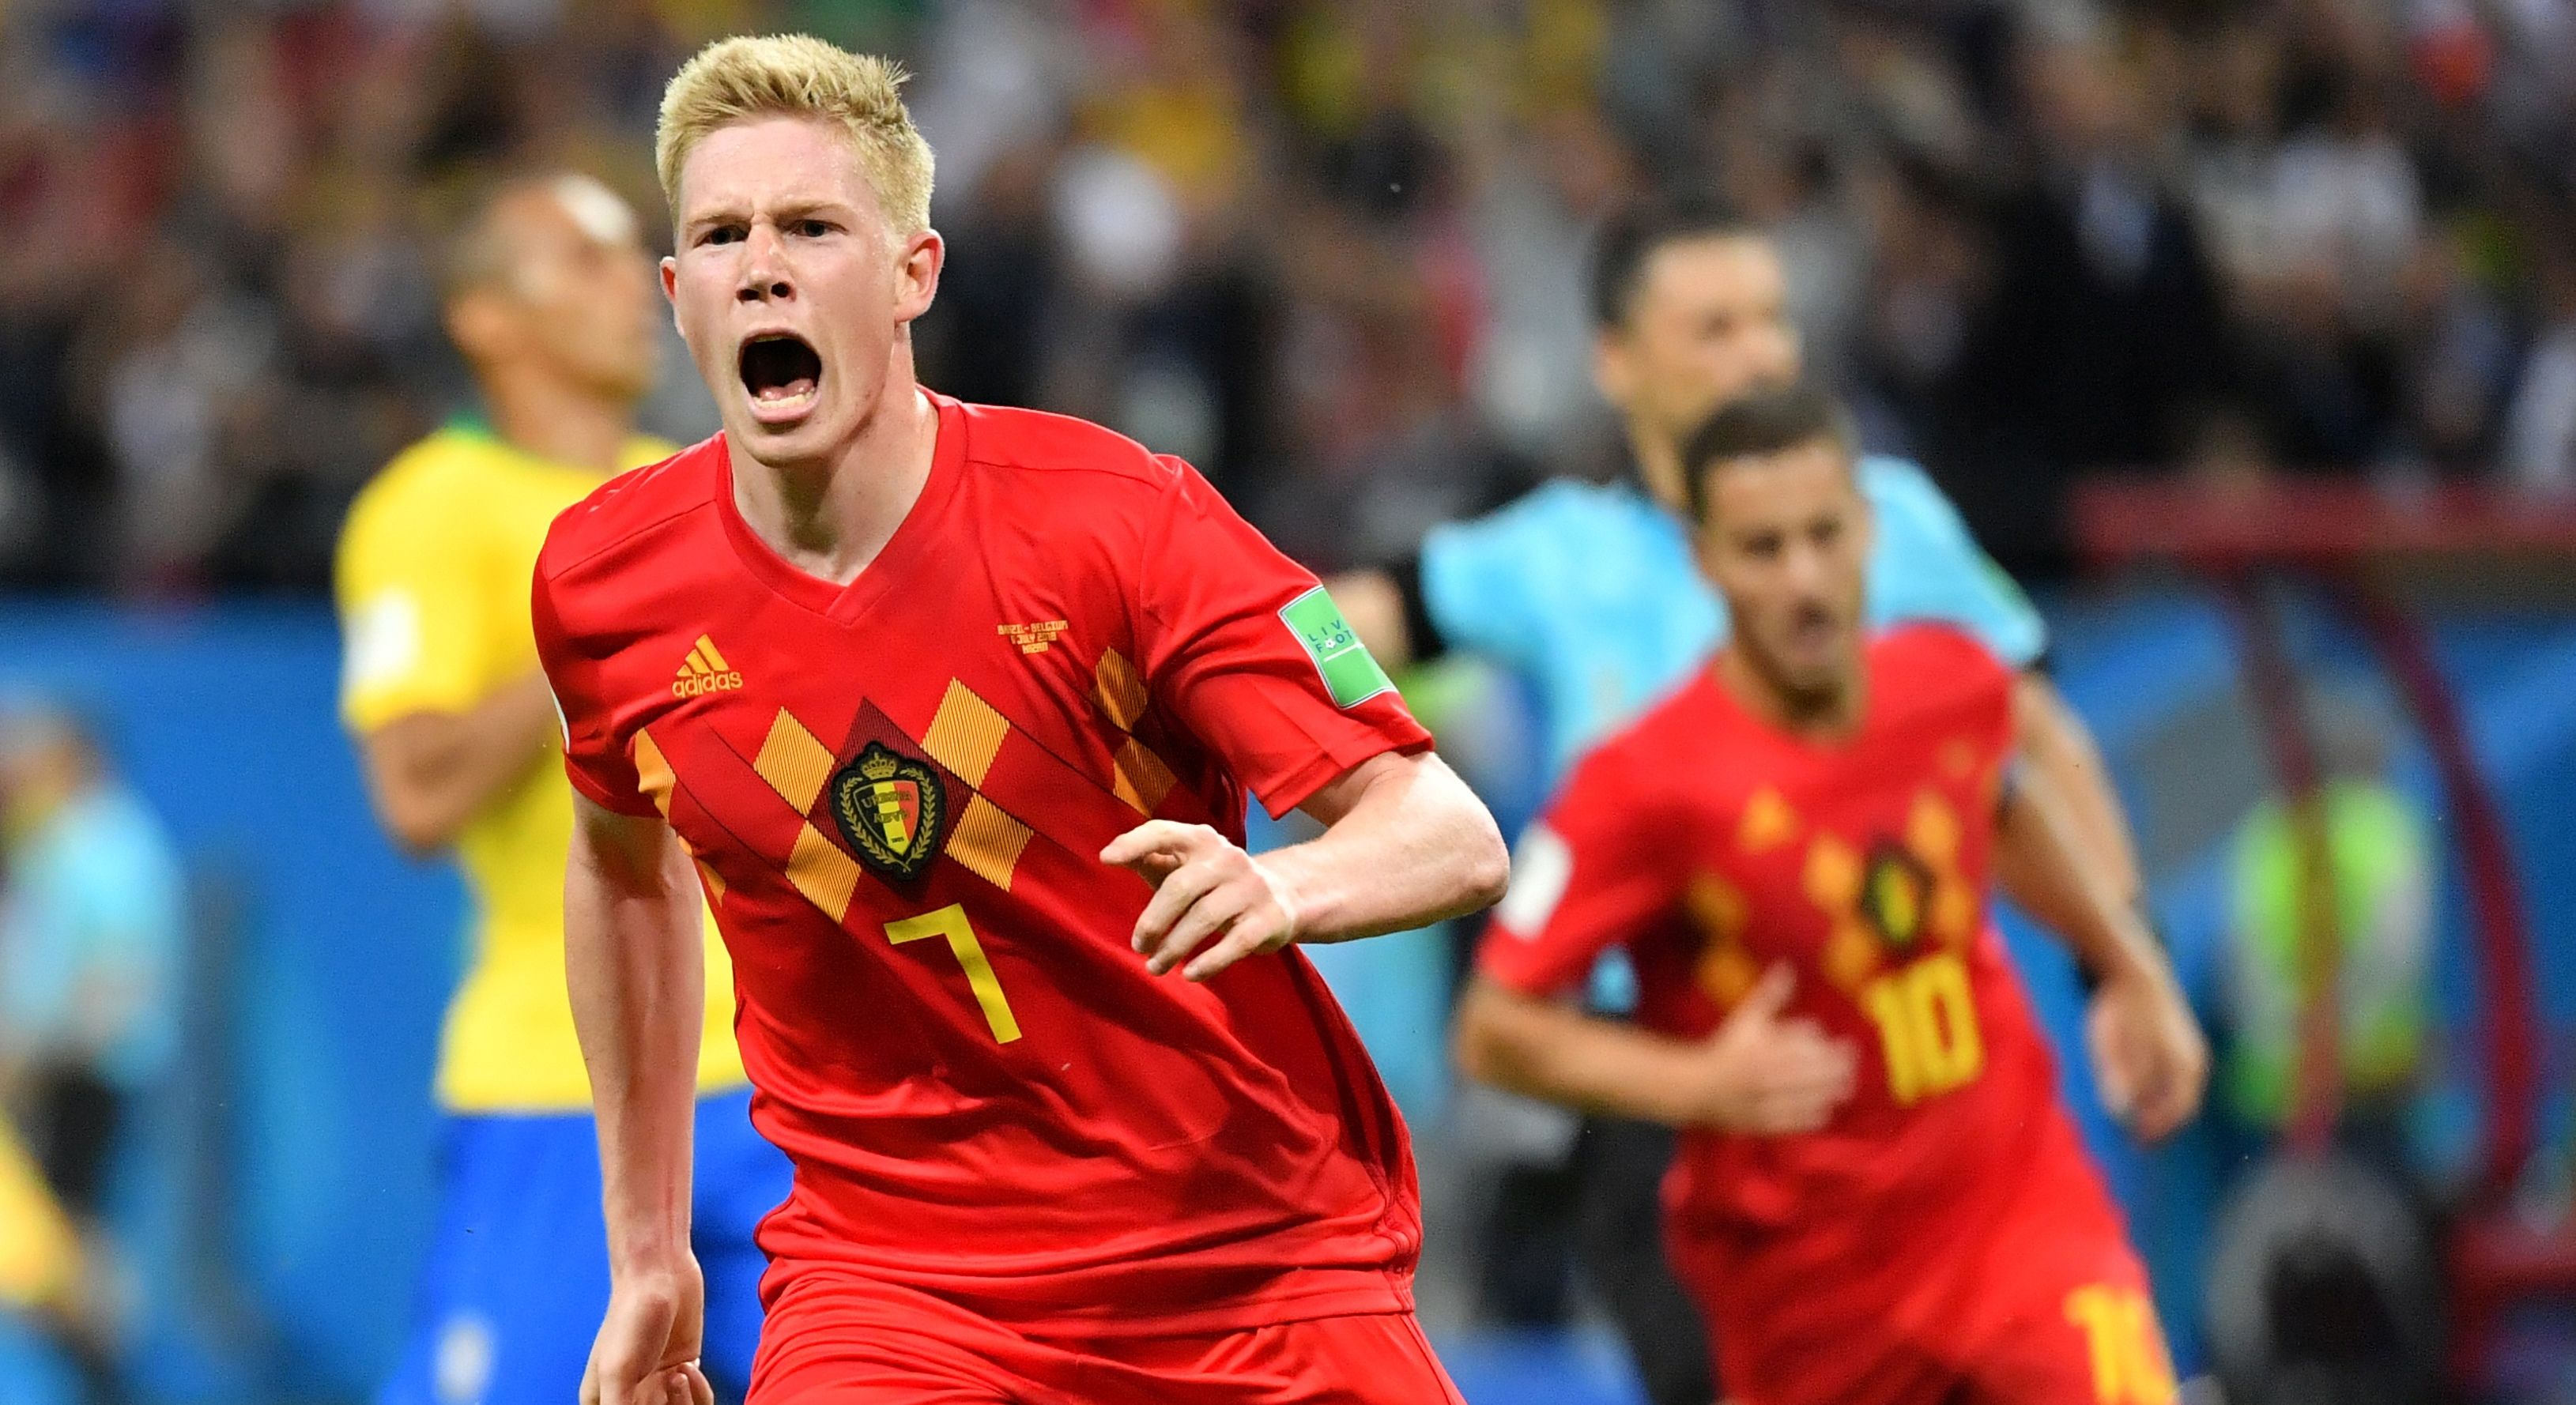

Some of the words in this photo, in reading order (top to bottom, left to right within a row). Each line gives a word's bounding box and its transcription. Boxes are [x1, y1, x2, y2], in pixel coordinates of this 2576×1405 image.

[1307, 620, 1341, 642] LIV
[672, 671, 744, 699] adidas
[884, 902, 1023, 1045] 7
[1862, 951, 1987, 1103] 10
